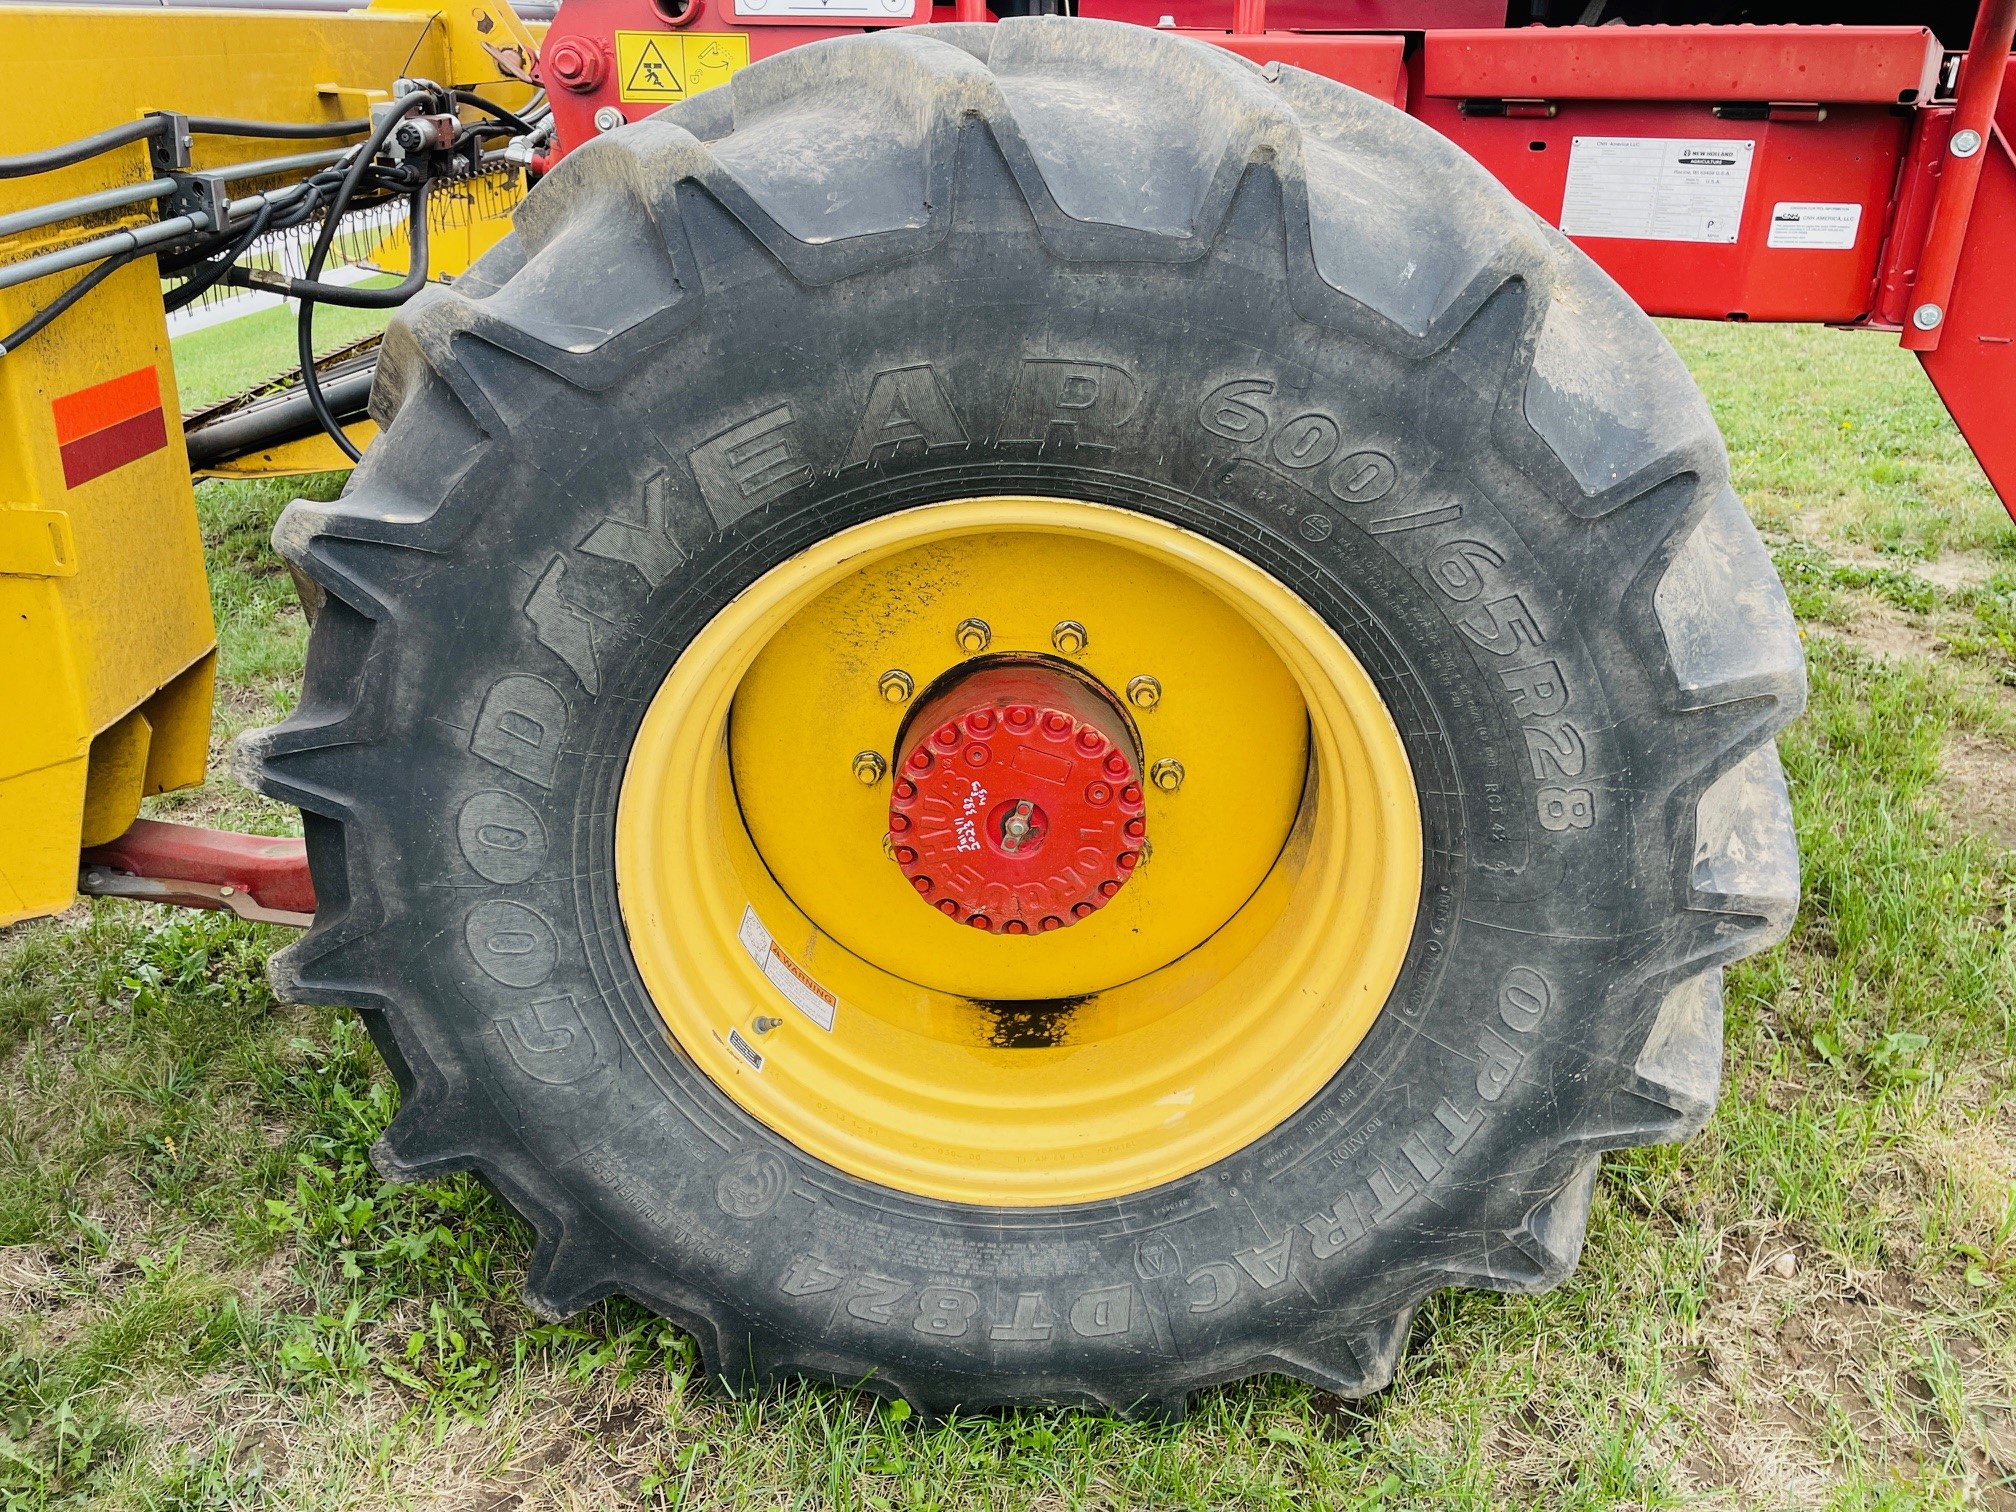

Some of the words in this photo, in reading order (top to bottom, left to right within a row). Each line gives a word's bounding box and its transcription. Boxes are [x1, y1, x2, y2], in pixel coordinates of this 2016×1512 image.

[1198, 379, 1594, 832] 600/65R28
[612, 611, 646, 650] TITAN
[456, 361, 1144, 1086] GOODYEAR
[963, 820, 980, 850] 2023
[780, 956, 833, 1005] WARNING
[1302, 1106, 1336, 1135] NOTCH
[1334, 1086, 1356, 1107] PRY
[1185, 966, 1550, 1313] OPTITRAC
[1323, 1115, 1388, 1168] ROTATION
[582, 1152, 666, 1228] TUBELESS
[675, 1225, 744, 1274] RADIAL
[926, 1273, 972, 1287] WARNING
